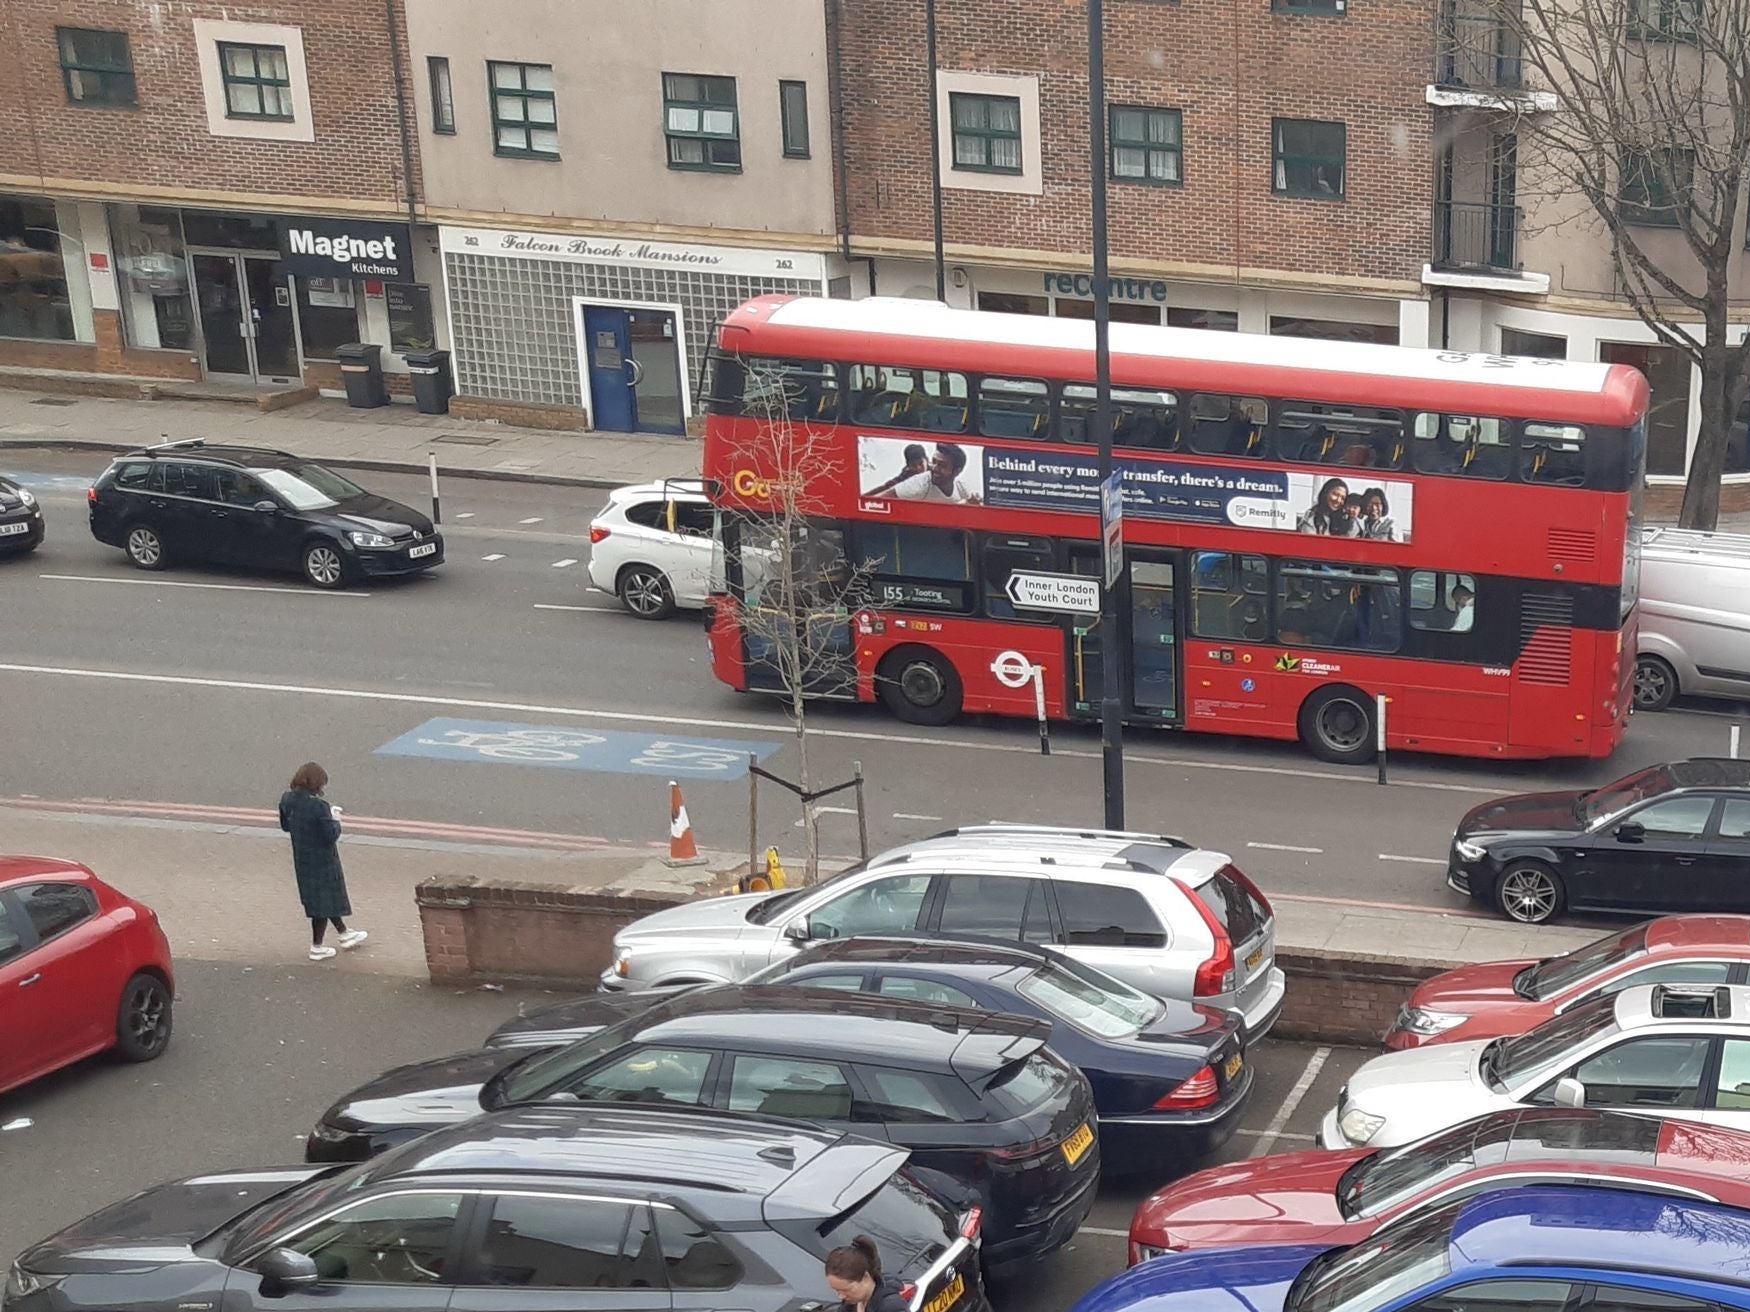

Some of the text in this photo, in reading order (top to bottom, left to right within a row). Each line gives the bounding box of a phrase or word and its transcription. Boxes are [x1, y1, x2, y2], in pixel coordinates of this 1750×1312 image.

[289, 229, 397, 263] Magnet
[501, 234, 723, 265] Falcon Brook Mansions
[352, 263, 399, 275] Kitchens
[776, 259, 793, 270] 262
[1044, 272, 1167, 301] recntre
[988, 456, 1036, 473] Behind
[1038, 463, 1075, 478] every
[1122, 470, 1179, 486] transfer,
[1181, 473, 1224, 488] there's
[1226, 481, 1234, 489] a
[1236, 477, 1283, 493] dream.
[1249, 508, 1286, 520] Remitly
[884, 586, 904, 600] 155
[1025, 579, 1095, 595] Inner London
[1029, 592, 1092, 607] Youth Court
